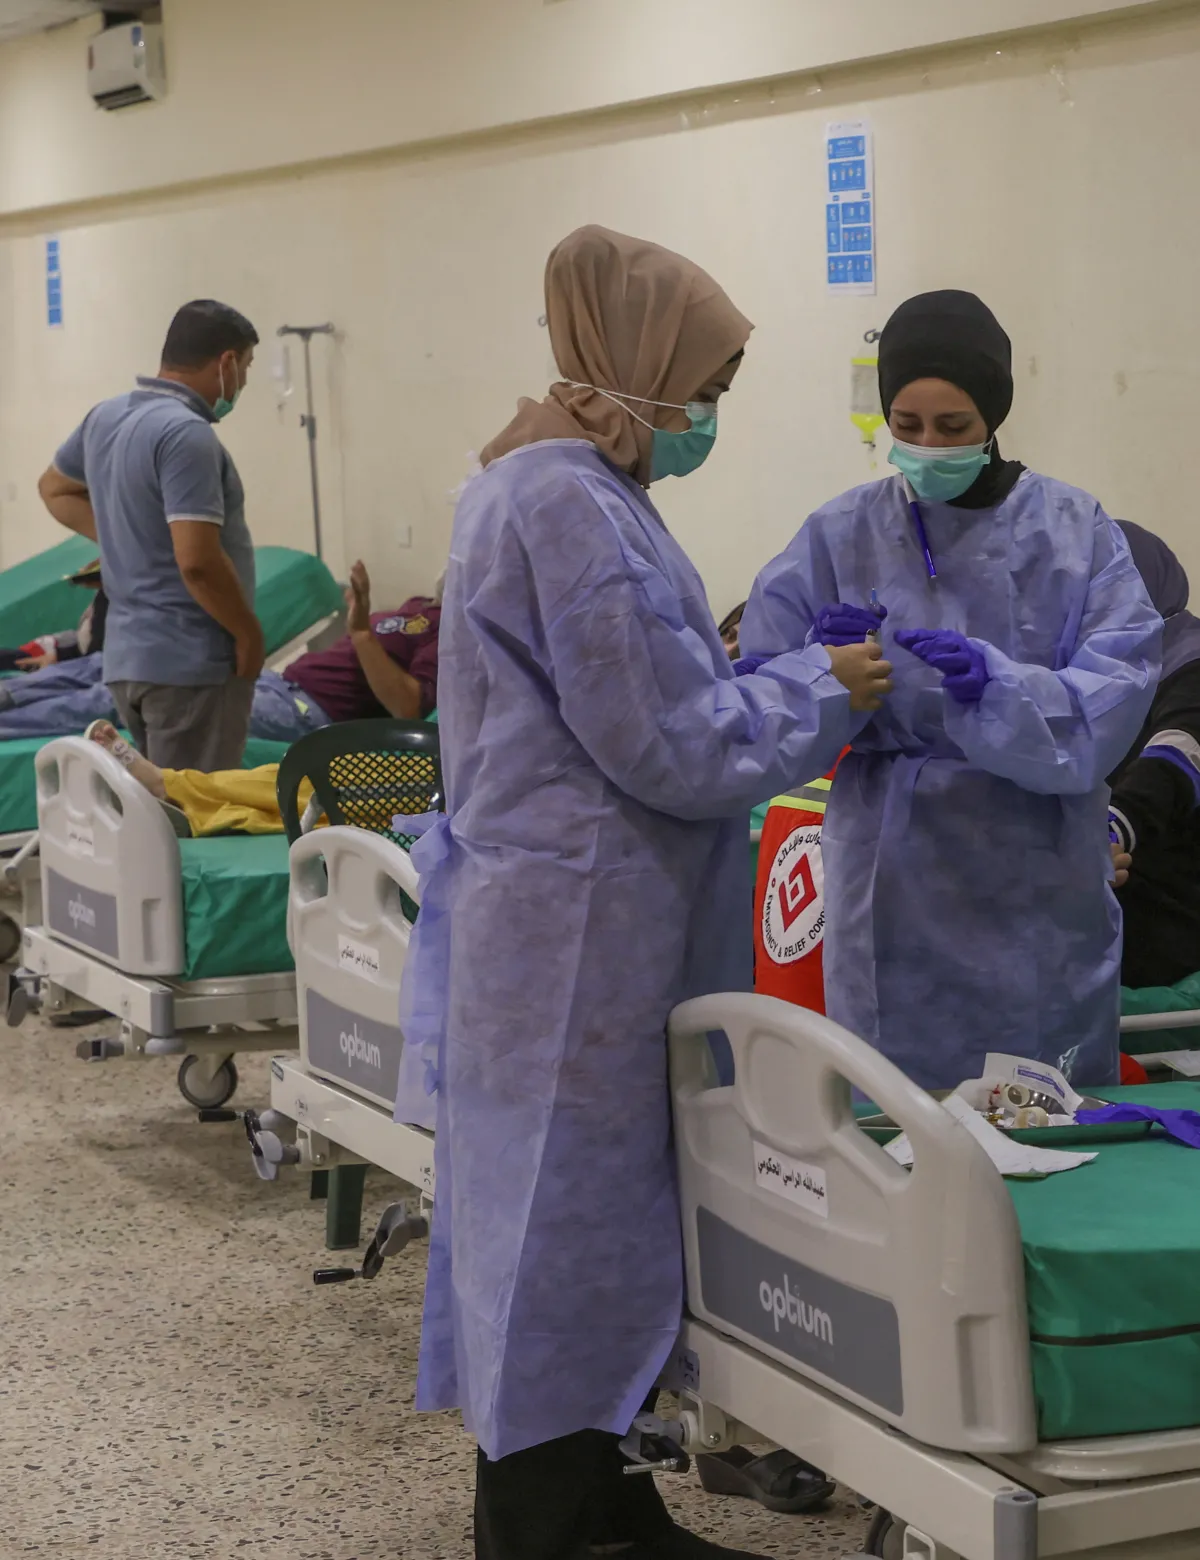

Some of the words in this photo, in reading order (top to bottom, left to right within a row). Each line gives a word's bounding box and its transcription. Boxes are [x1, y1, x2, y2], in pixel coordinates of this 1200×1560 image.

[764, 894, 779, 953] EMERGENCY
[783, 937, 806, 958] RELIEF
[808, 906, 826, 940] CORP
[339, 1022, 381, 1070] optium
[757, 1157, 782, 1176] الحكومي
[782, 1169, 802, 1188] الراسي
[759, 1273, 834, 1347] optium
